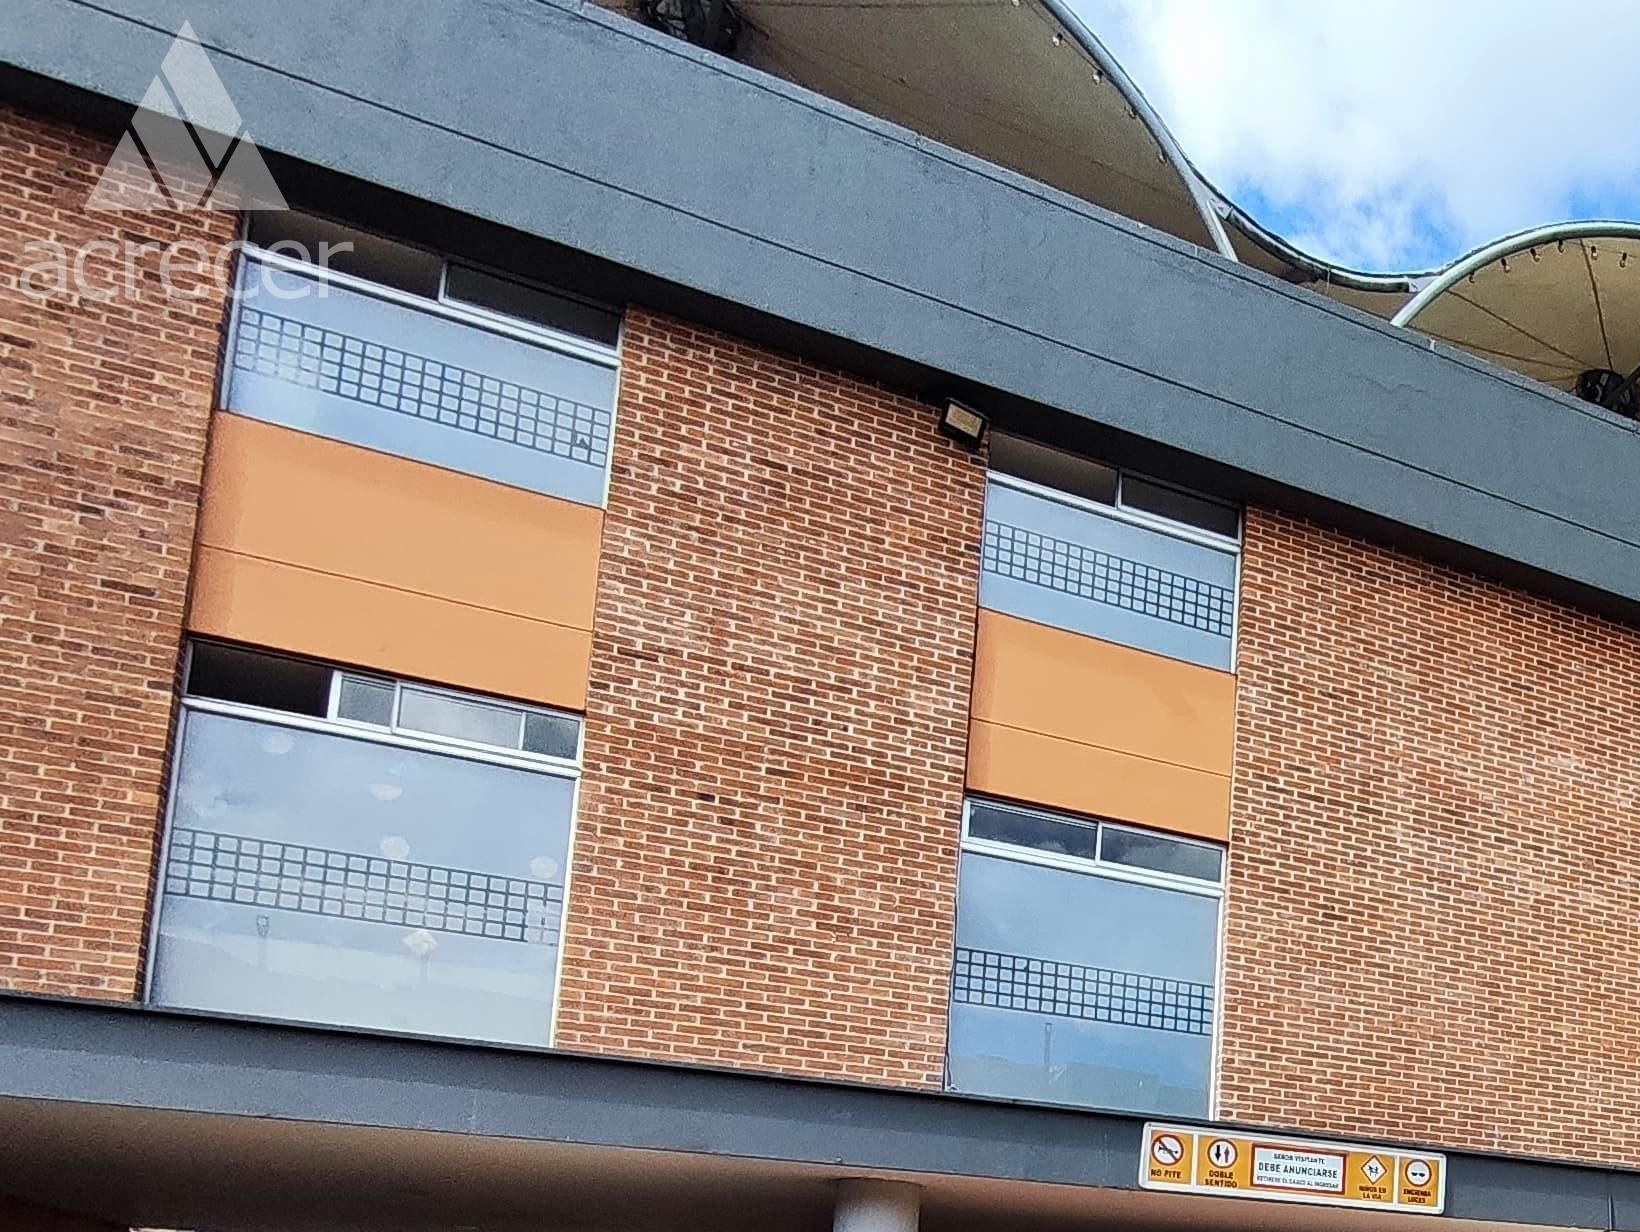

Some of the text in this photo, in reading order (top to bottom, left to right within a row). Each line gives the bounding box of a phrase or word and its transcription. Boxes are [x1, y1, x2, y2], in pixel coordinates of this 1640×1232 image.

[1150, 1168, 1182, 1179] NO PITE
[1208, 1169, 1234, 1179] DOBLE
[1258, 1162, 1338, 1179] DEBE ANUNCIARSE
[1204, 1178, 1238, 1188] SENTIDO
